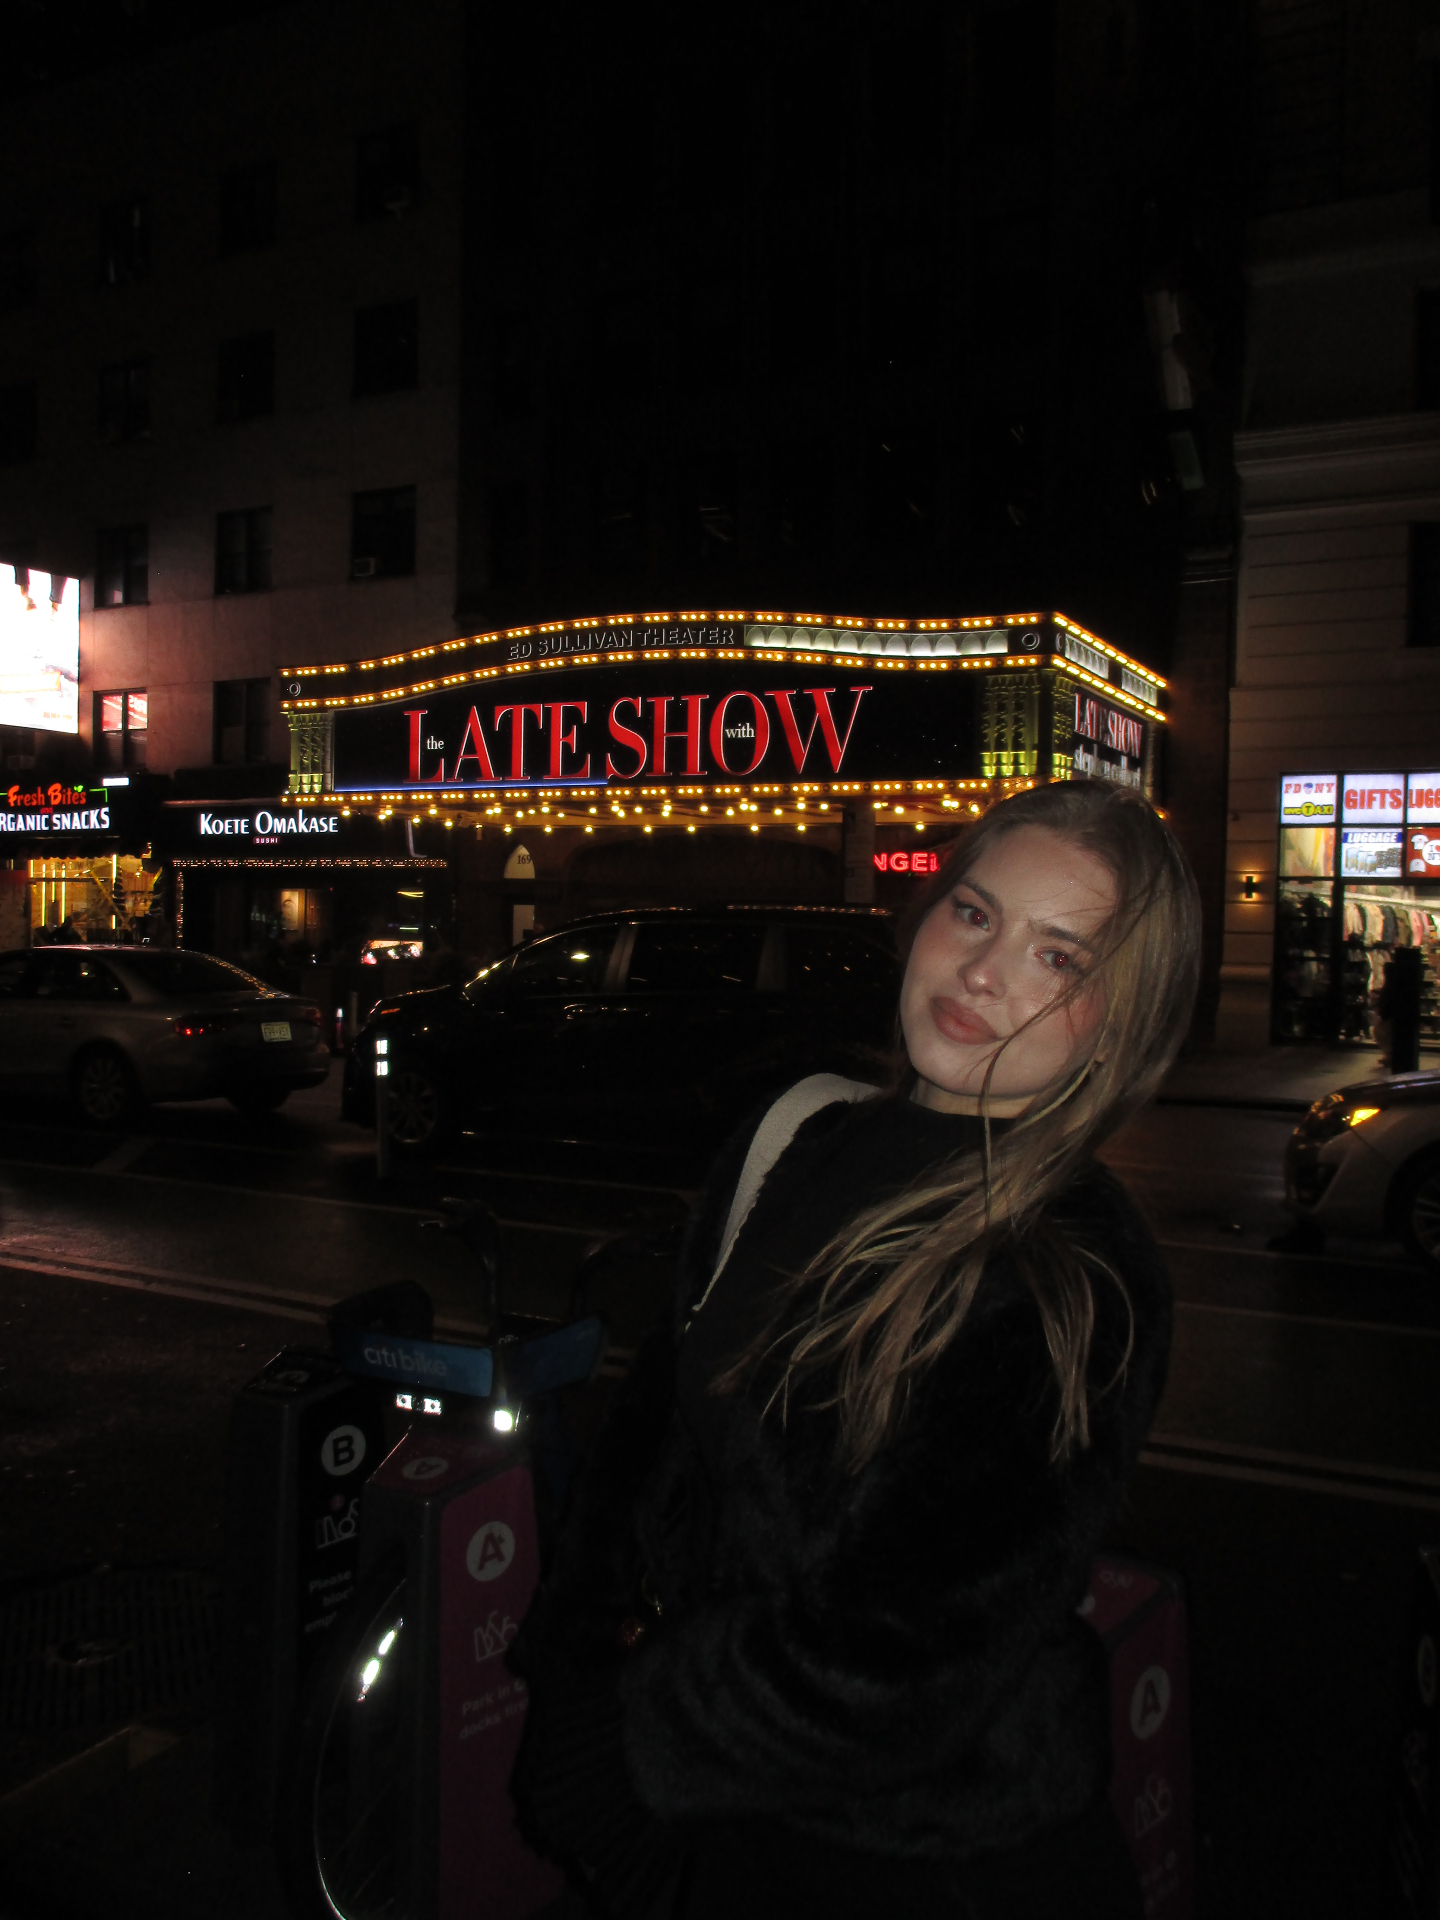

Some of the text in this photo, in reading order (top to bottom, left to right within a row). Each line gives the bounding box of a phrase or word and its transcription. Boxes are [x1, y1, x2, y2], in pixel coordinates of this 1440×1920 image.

[507, 628, 735, 660] ED SULLIVAN THEATER
[403, 686, 873, 784] LATE SHOW
[427, 735, 444, 750] the
[725, 723, 755, 738] with
[7, 782, 86, 807] Fresh Bites
[1344, 789, 1402, 809] GIFTS
[52, 807, 110, 831] SNACKS
[200, 813, 250, 835] KOETE
[1347, 832, 1398, 843] LUGGAGE
[398, 1348, 447, 1377] bike
[332, 1434, 356, 1467] B
[478, 1532, 506, 1571] A
[1138, 1678, 1162, 1727] A
